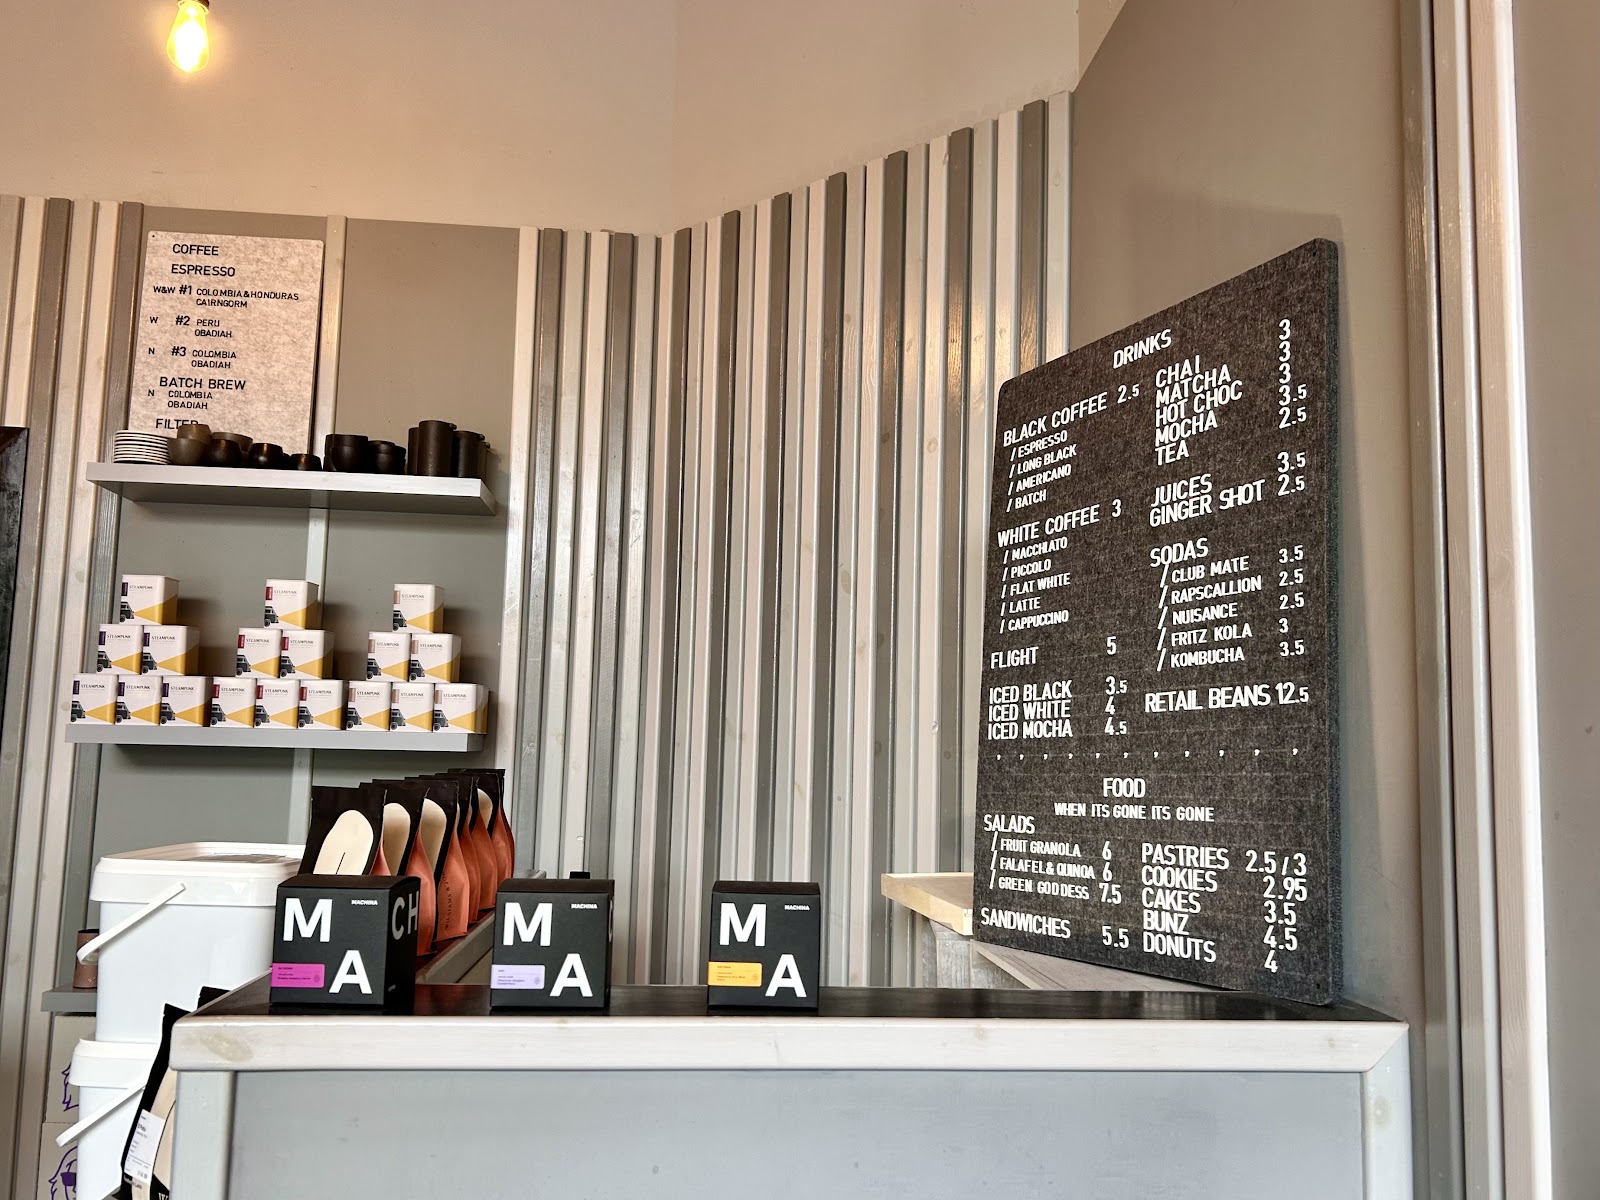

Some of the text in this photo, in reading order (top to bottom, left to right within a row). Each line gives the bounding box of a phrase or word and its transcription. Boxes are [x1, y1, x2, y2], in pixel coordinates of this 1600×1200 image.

[172, 244, 219, 256] COFFEE
[171, 264, 236, 277] ESPRESSO
[153, 285, 176, 294] W&W
[179, 285, 193, 296] #1
[196, 298, 248, 308] CAIRNGORM
[150, 316, 220, 328] W #2 PERU
[194, 329, 232, 338] OBADIAH
[172, 346, 186, 357] #3
[192, 350, 237, 359] COLOMBIA
[1112, 328, 1172, 369] DRINKS
[1155, 318, 1291, 388] CHAI 3
[191, 360, 231, 368] OBADIAH
[1156, 340, 1291, 408] MATCHA 3
[159, 376, 246, 390] BATCH BREW
[168, 390, 213, 399] COLOMBIA
[1156, 362, 1291, 428] HOT CHOC 3
[168, 400, 208, 410] OBADIAH
[1003, 384, 1140, 447] BLACK COFFEE 2.5
[1155, 384, 1307, 447] MOCHA 3.5
[1018, 430, 1068, 458] ESPRESSO
[1155, 406, 1307, 466] TEA 2.5
[1017, 456, 1042, 474] LONG
[1044, 444, 1077, 466] BLACK
[1016, 464, 1072, 492] AMERICANO
[1150, 452, 1306, 507] JUICES 3.5
[1014, 489, 1047, 510] BATCH
[1150, 474, 1305, 527] GINGER SHOT 2.5
[998, 498, 1122, 548] WHITE COFFEE 3
[1012, 536, 1068, 562] MACCHIATO
[1150, 538, 1208, 567] SODAS
[1010, 558, 1052, 578] PICCOLO
[1172, 564, 1205, 584] CLUB
[1210, 556, 1250, 576] MATE
[1278, 545, 1304, 564] 3.5
[1010, 580, 1034, 597] FLAT
[1037, 572, 1071, 590] WHITE
[1171, 575, 1262, 604] RAPSCALLION
[1278, 568, 1304, 587] 2.5
[1008, 596, 1041, 614] LATTE
[1172, 602, 1238, 626] NUISANCE
[1279, 592, 1305, 610] 2.5
[1008, 610, 1070, 632] CAPPUCCINO
[1171, 628, 1208, 647] FRITZ
[1214, 622, 1252, 642] KOLA
[1278, 618, 1289, 634] 3
[990, 636, 1117, 670] FLIGHT 5
[1170, 646, 1245, 668] KOMBUCHA
[1279, 640, 1305, 657] 3.5
[990, 676, 1128, 704] ICED BLACK 3.5
[1144, 682, 1309, 712] RETAIL BEANS 12.5
[988, 696, 1116, 722] ICED WHITE 4
[988, 717, 1127, 740] ICED MOCHA 4.5
[1103, 778, 1146, 798] FOOD
[984, 814, 1036, 834] SALADS
[1054, 803, 1214, 822] WHEN ITS GONE ITS GONE
[1000, 838, 1028, 852] FRUIT
[1030, 840, 1082, 858] GRANOLA
[1102, 841, 1112, 860] 6
[1142, 842, 1230, 870] PASTRIES
[1056, 863, 1096, 880] QUINOA
[1102, 862, 1112, 882] 6
[1142, 866, 1308, 902] COOKIES 2.95
[998, 876, 1033, 893] GREEN
[1099, 882, 1122, 904] 7.5
[283, 898, 332, 942] M
[1142, 888, 1296, 926] CAKES 3.5
[503, 902, 552, 946] M
[720, 902, 766, 946] M
[980, 908, 1130, 949] SANDWICHES 5.5
[1143, 909, 1298, 951] BUNZ 4.5
[1142, 932, 1278, 973] DONUTS 4
[328, 950, 372, 994] A
[550, 953, 594, 998] A
[765, 954, 807, 998] A
